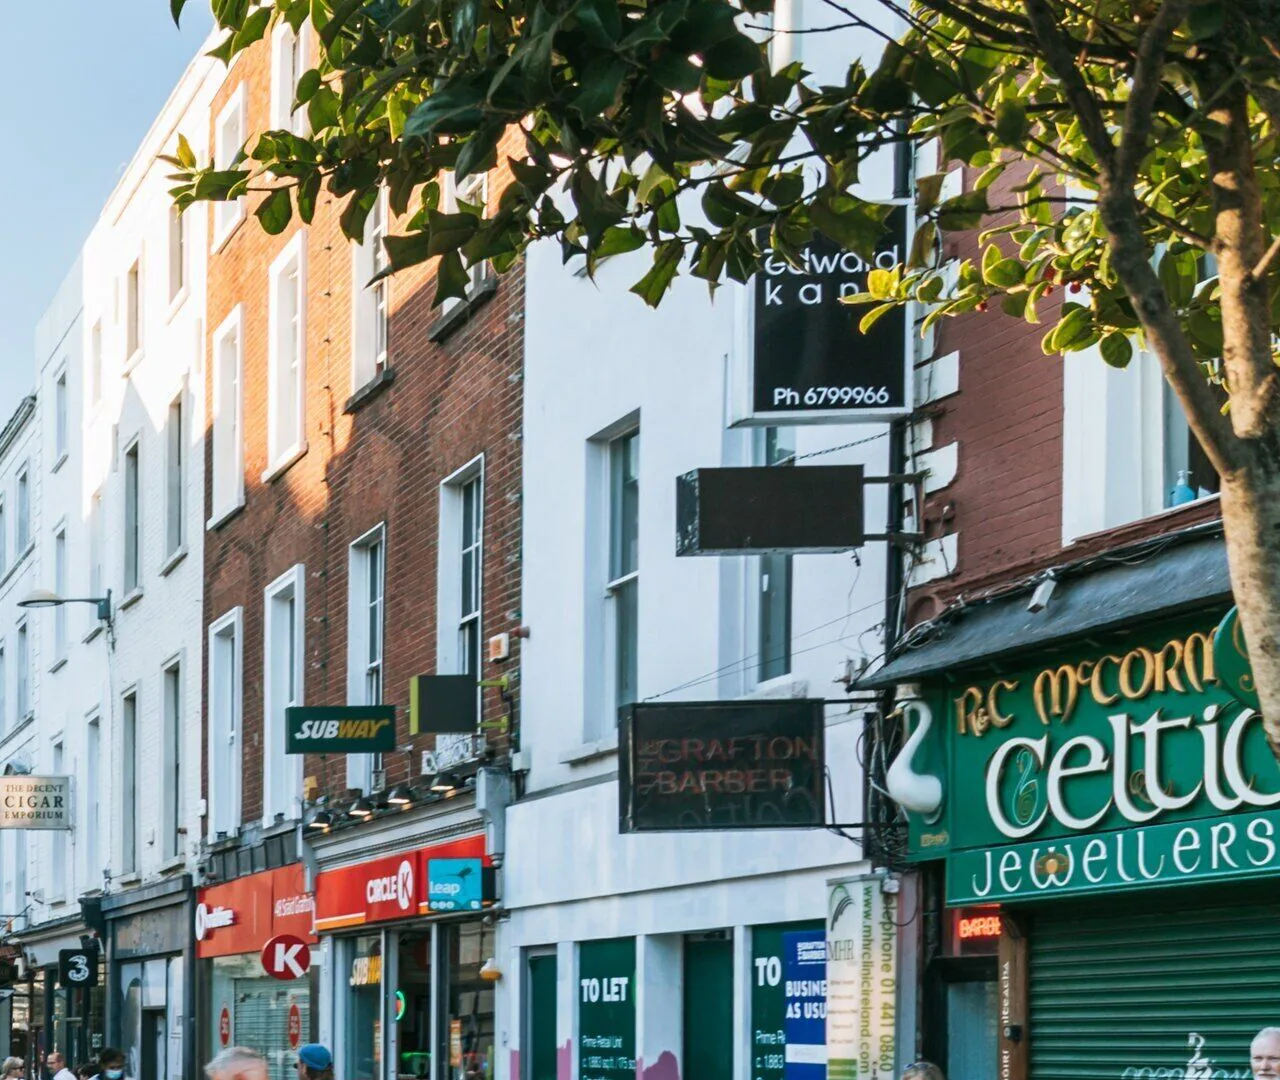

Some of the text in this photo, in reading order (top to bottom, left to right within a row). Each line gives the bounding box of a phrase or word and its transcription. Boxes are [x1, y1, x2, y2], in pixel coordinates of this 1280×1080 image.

[773, 387, 889, 405] Ph 6799966
[295, 719, 389, 739] SUBWAY
[656, 735, 817, 763] GRAFTON
[656, 768, 792, 794] BARBER
[4, 795, 64, 808] CIGAR
[5, 811, 63, 819] EMPORIUM
[366, 875, 397, 904] CIRCLE
[68, 954, 90, 982] 3
[274, 943, 305, 979] K
[755, 957, 781, 987] TO
[581, 977, 629, 1003] TO LET
[786, 1003, 801, 1019] AS
